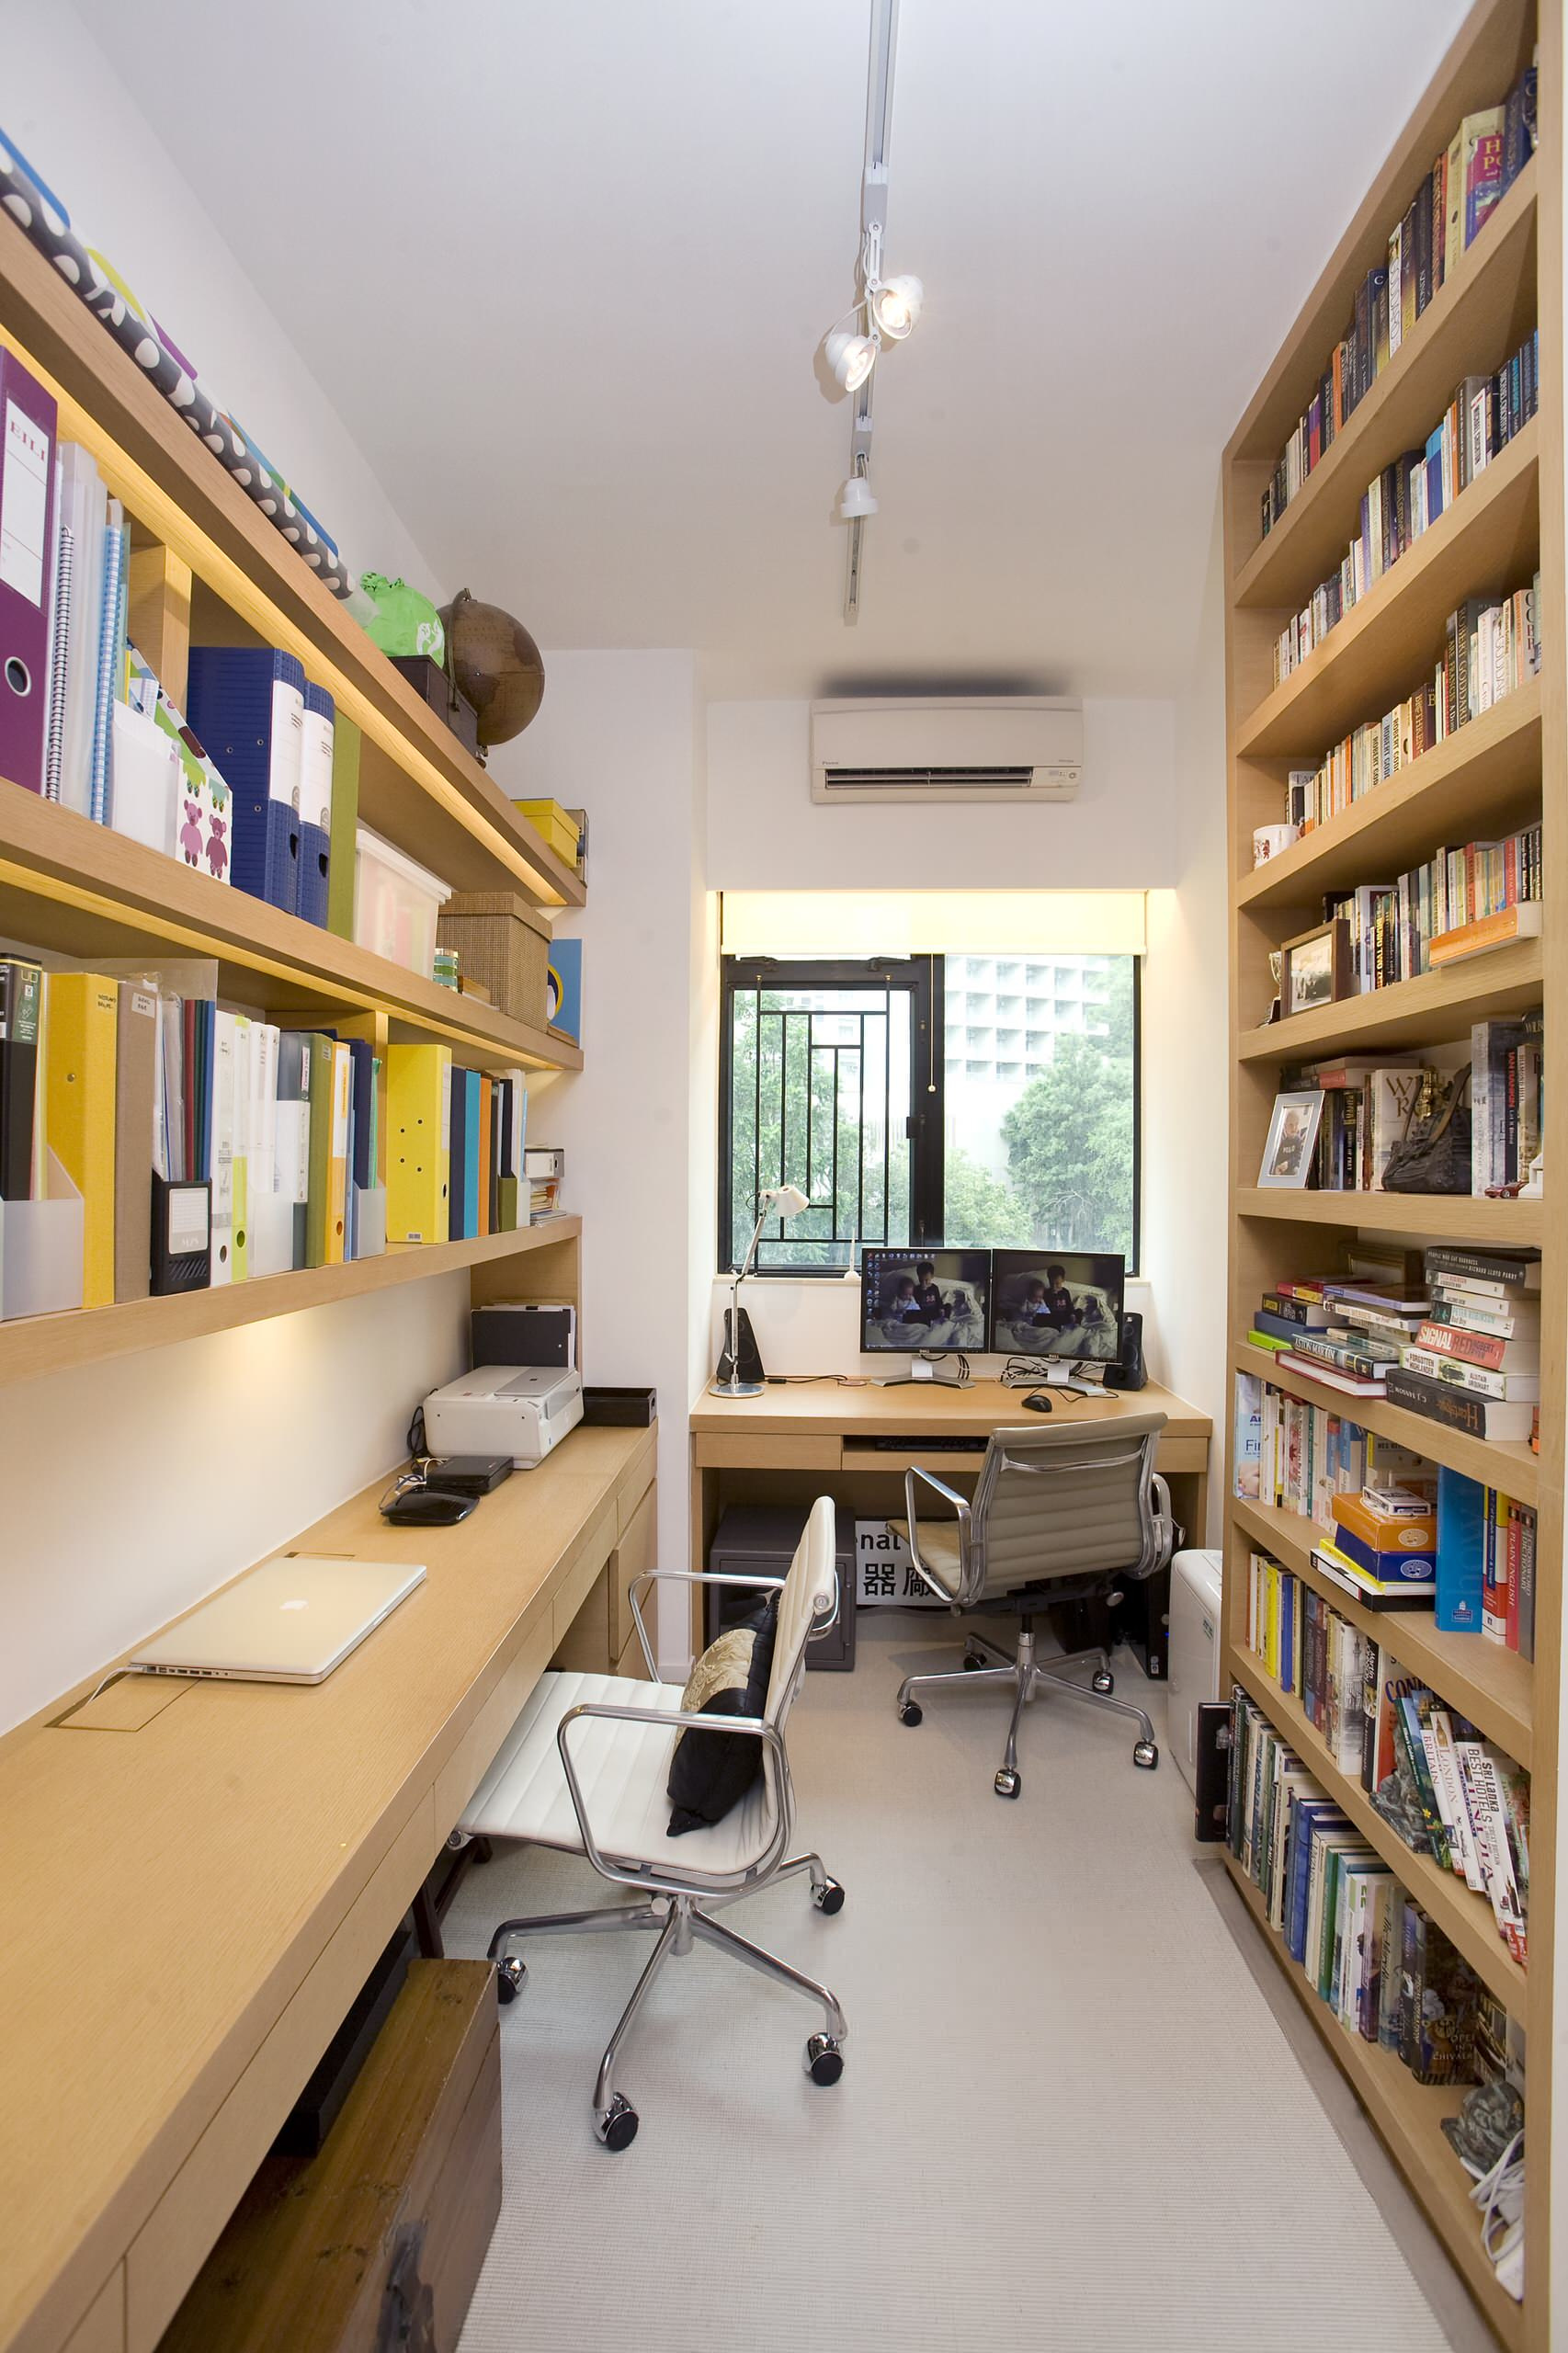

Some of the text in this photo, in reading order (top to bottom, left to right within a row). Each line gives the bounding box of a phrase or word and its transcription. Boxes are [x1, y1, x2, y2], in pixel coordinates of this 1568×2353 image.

[1459, 659, 1468, 726] GODDARD
[1295, 1337, 1336, 1359] ASTON MARTIN
[1418, 1325, 1472, 1355] SIGNAL RED
[1409, 1353, 1435, 1367] FORGOTTEN
[1409, 1361, 1435, 1376] HIGHLANDER
[855, 1533, 901, 1551] nal
[1424, 1735, 1439, 1784] BRITAIN
[1468, 1748, 1483, 1778] BEST
[1482, 1762, 1494, 1780] SRI
[1439, 1749, 1458, 1802] LONDON
[1474, 1779, 1493, 1824] HOTELS
